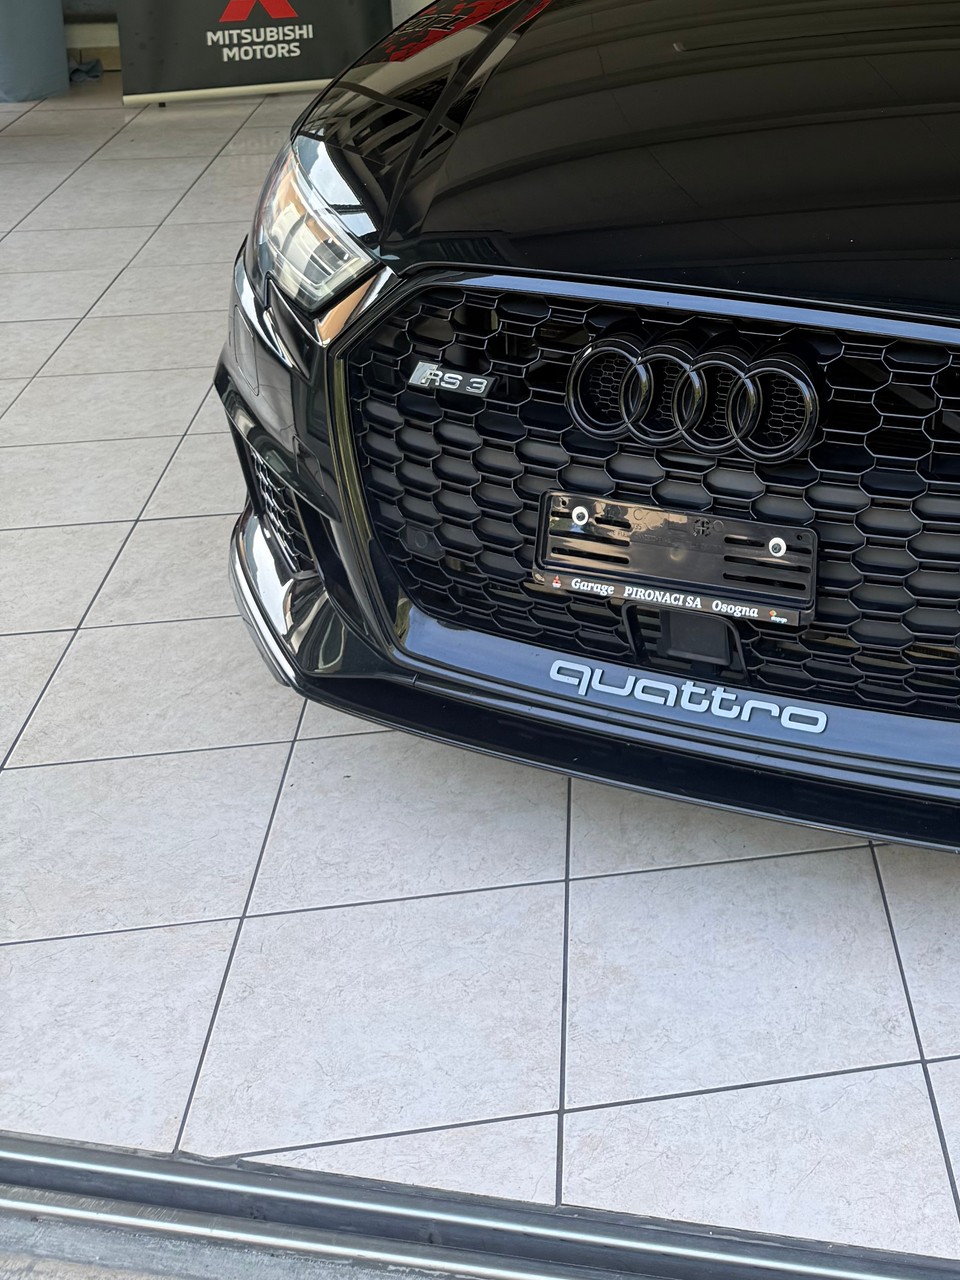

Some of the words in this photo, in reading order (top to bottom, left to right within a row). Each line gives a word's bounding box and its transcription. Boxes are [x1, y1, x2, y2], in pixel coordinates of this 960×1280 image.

[206, 24, 314, 46] MITSUBISHI
[222, 42, 301, 62] MOTORS
[465, 377, 488, 394] 3
[571, 577, 615, 596] Garage
[623, 585, 684, 606] PIRONACI
[685, 595, 702, 609] SA
[711, 599, 759, 618] Osogna
[549, 659, 828, 734] quattro
